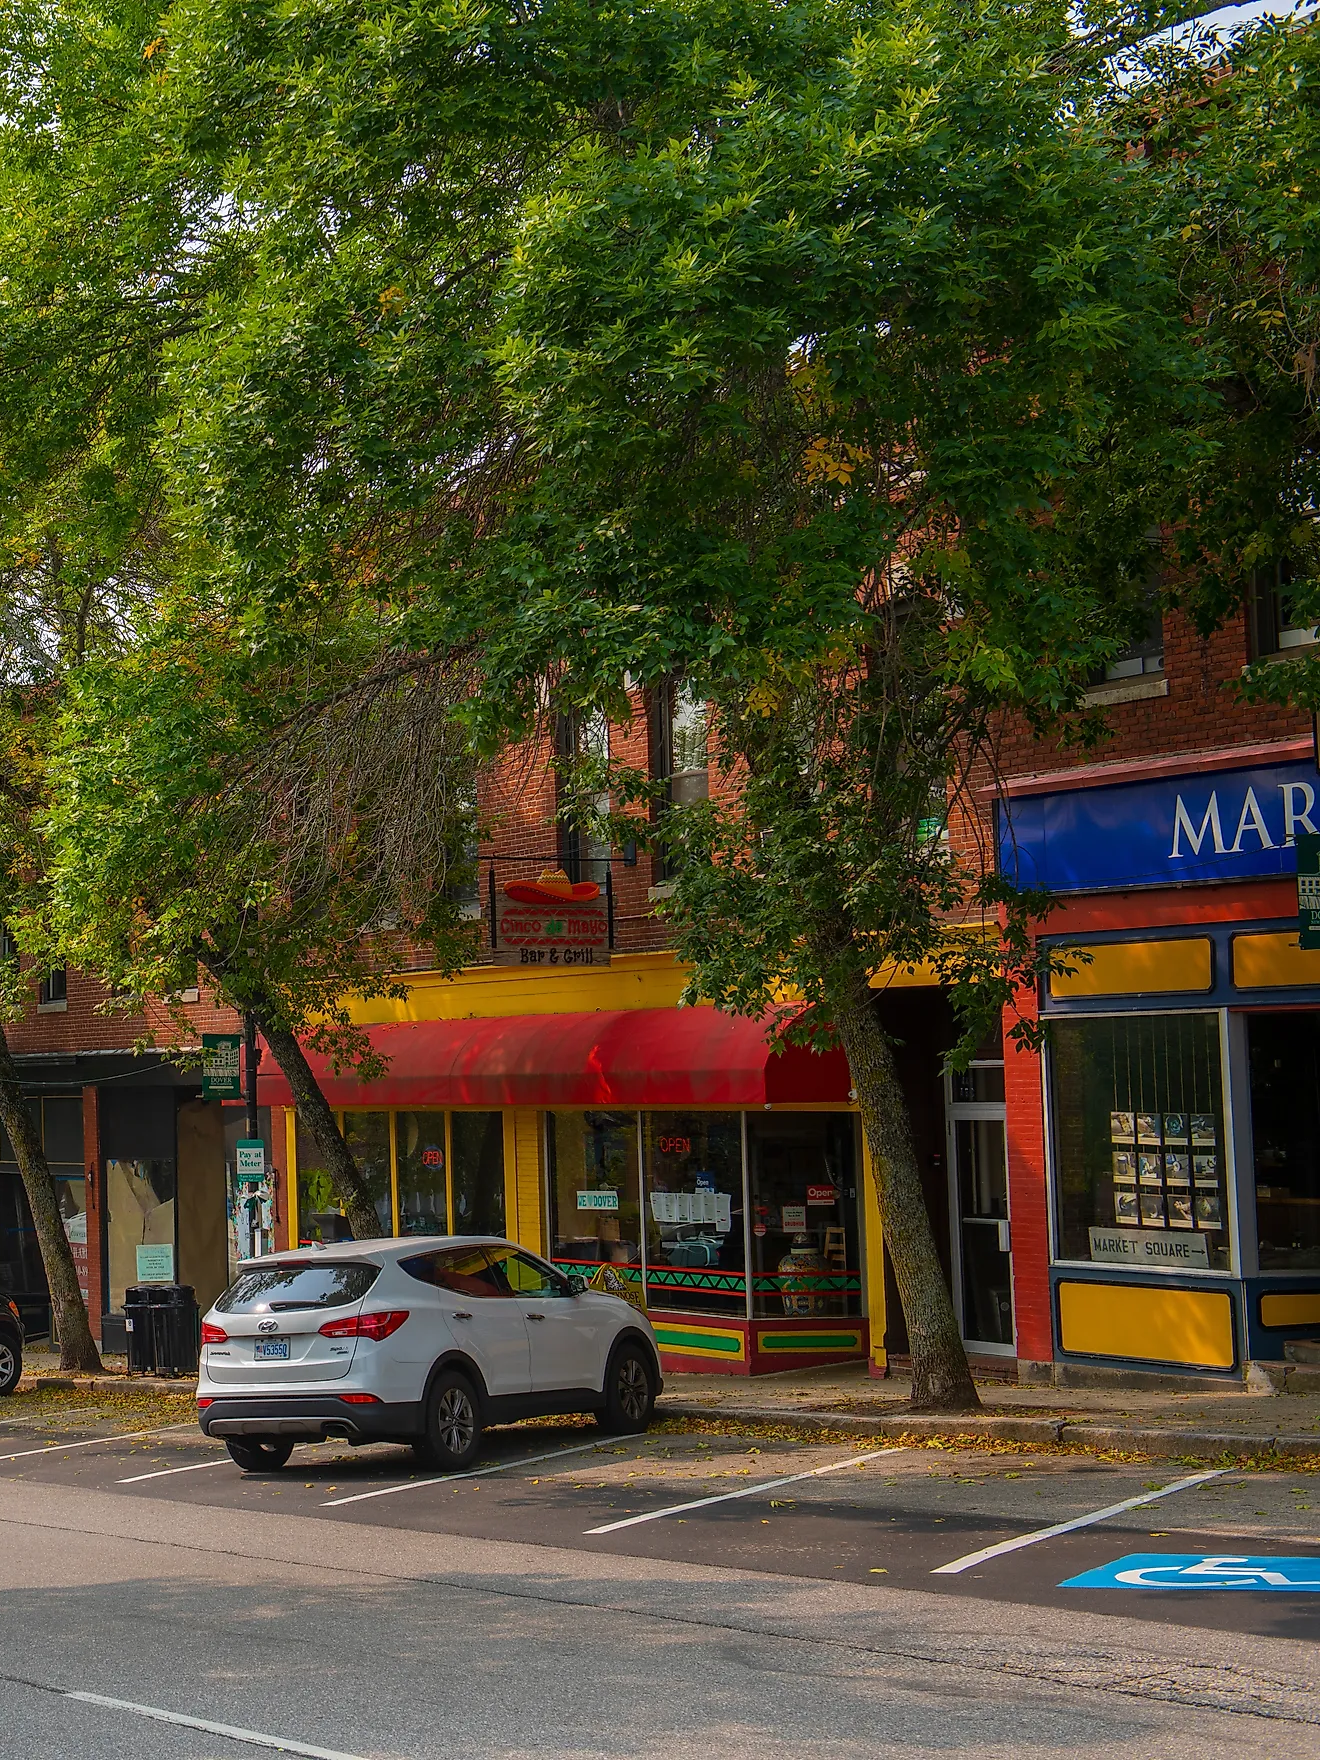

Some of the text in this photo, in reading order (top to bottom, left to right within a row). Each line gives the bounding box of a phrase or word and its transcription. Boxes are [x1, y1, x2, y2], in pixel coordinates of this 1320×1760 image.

[500, 918, 608, 935] Cinco de Mayo
[520, 947, 594, 964] Bar & Grill
[660, 1137, 691, 1153] OPEN
[239, 1151, 252, 1159] Pay
[422, 1151, 443, 1165] OPEN
[593, 1195, 618, 1207] DOVER
[1093, 1237, 1190, 1258] MARKET SQUARE
